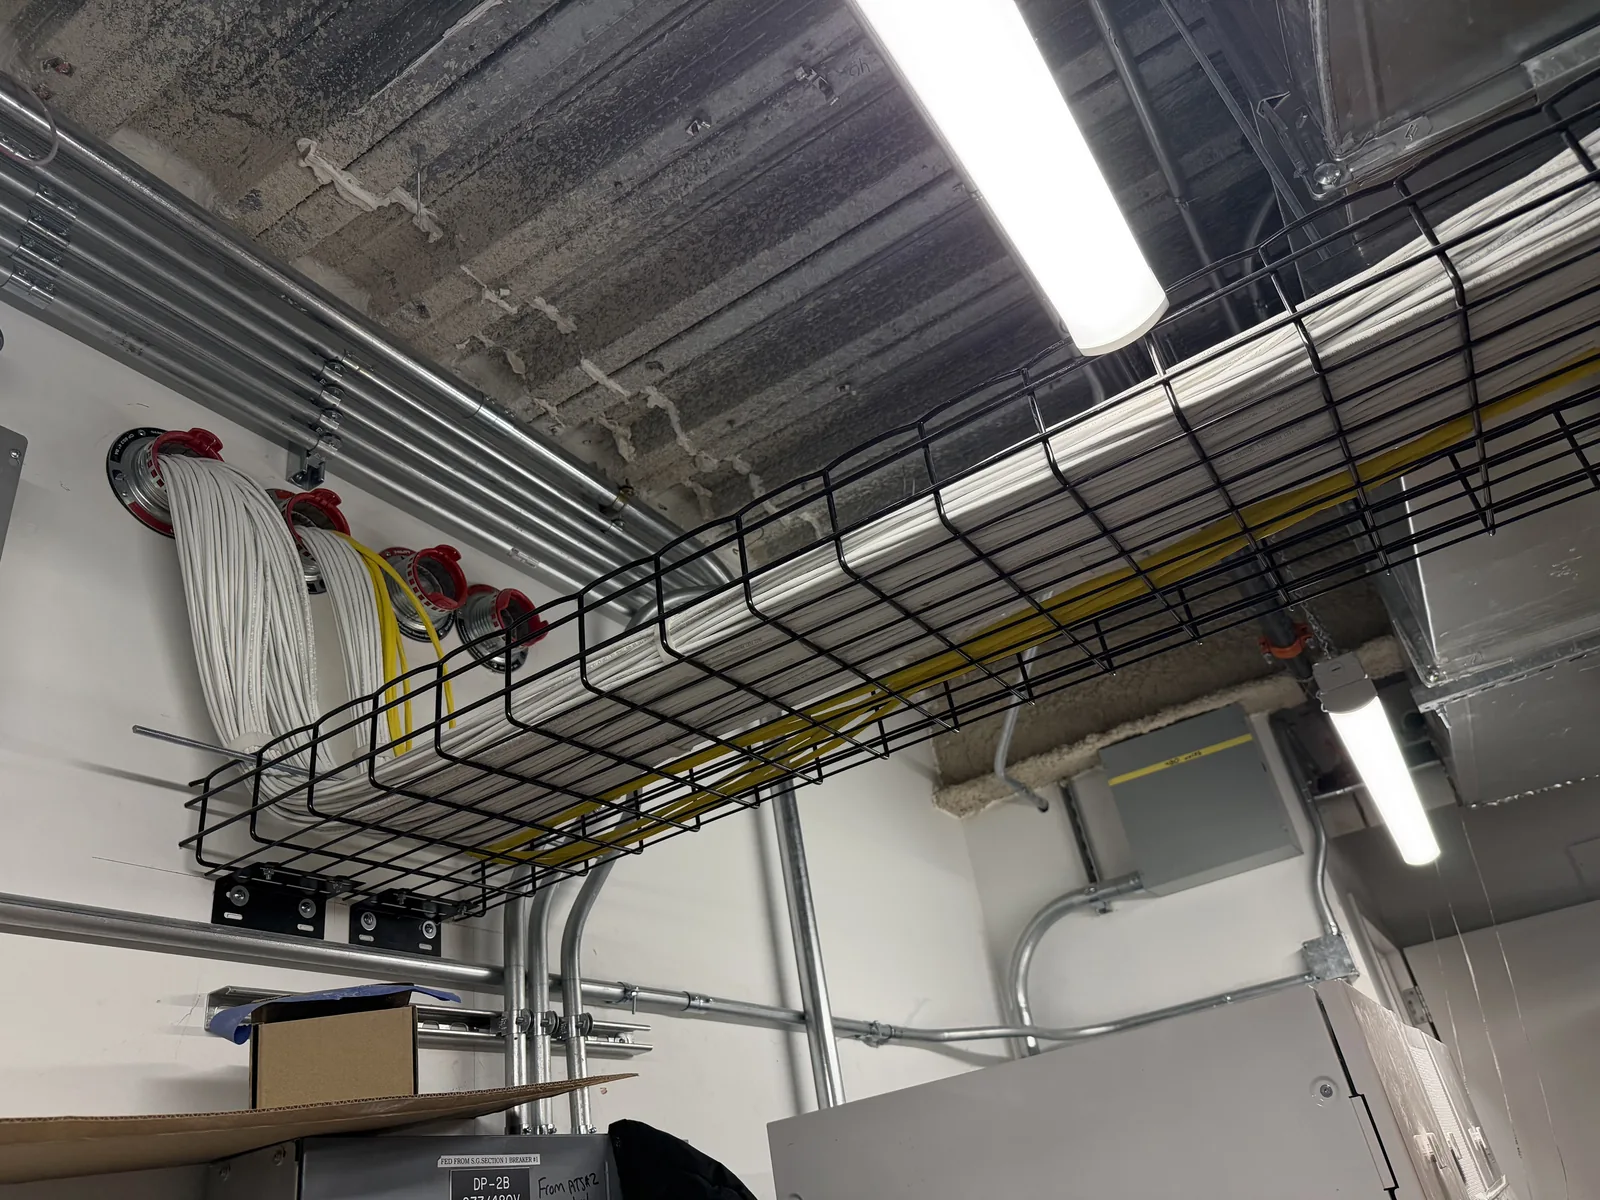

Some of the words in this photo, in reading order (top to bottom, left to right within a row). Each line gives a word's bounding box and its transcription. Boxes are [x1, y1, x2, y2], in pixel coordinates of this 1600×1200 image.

[440, 1157, 453, 1165] FED
[453, 1157, 470, 1165] FROM
[509, 1156, 532, 1164] BREAKER
[473, 1176, 510, 1191] DP-2B
[538, 1176, 566, 1199] From
